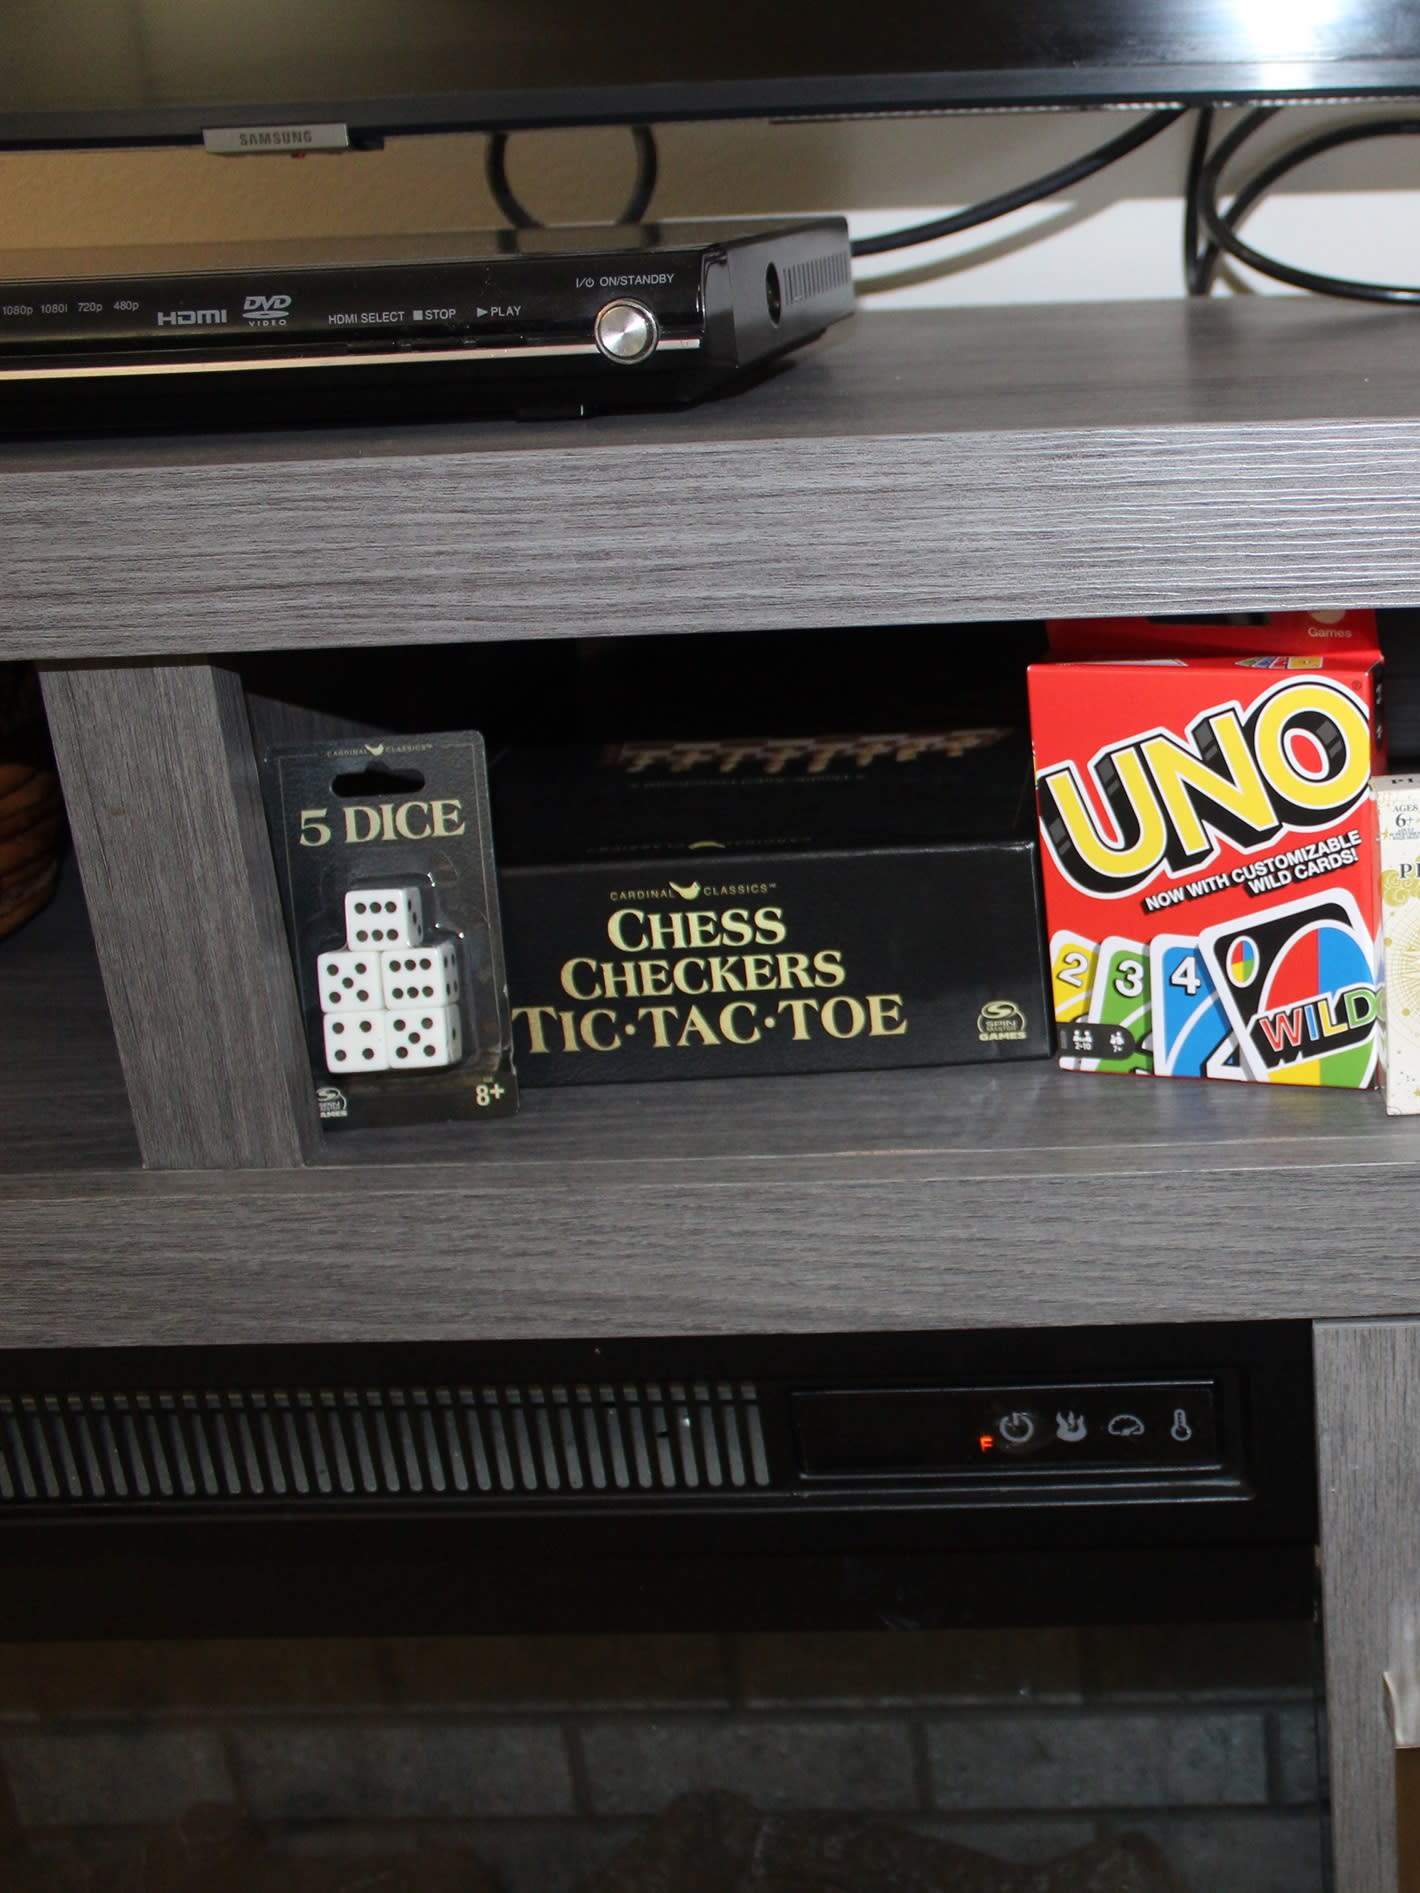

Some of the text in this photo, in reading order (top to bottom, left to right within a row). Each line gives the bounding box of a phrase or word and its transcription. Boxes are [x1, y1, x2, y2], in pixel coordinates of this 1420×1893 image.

[240, 131, 312, 146] SAMSUNG
[599, 274, 675, 287] ON/STANDBY
[2, 305, 34, 316] 1080p
[78, 302, 103, 313] 720p
[113, 300, 140, 312] 480p
[243, 295, 292, 311] DVD
[490, 305, 522, 317] PLAY
[157, 309, 228, 326] HDMI
[328, 311, 405, 325] HDMI SELECT
[424, 309, 457, 320] STOP
[249, 319, 287, 327] VIDEO
[1307, 626, 1353, 639] Games
[1040, 676, 1371, 886] UNO
[1393, 804, 1419, 813] AGES
[300, 799, 467, 847] 5 DICE
[1395, 813, 1415, 828] 6+
[1145, 888, 1186, 912] NOW
[1186, 874, 1231, 898] WITH
[1231, 830, 1362, 884] CUSTOMIZABLE
[1248, 847, 1360, 895] WILD CARDS!
[609, 888, 677, 901] CARDINAL
[606, 907, 788, 953] CHESS
[559, 950, 848, 1001] CHECKERS
[1058, 953, 1089, 987] 2
[1171, 956, 1201, 995] 4
[1114, 960, 1144, 998] 3
[1258, 988, 1381, 1052] WILD
[978, 1032, 1027, 1041] GAMES
[475, 1083, 505, 1106] 8+
[320, 1110, 348, 1118] AMES
